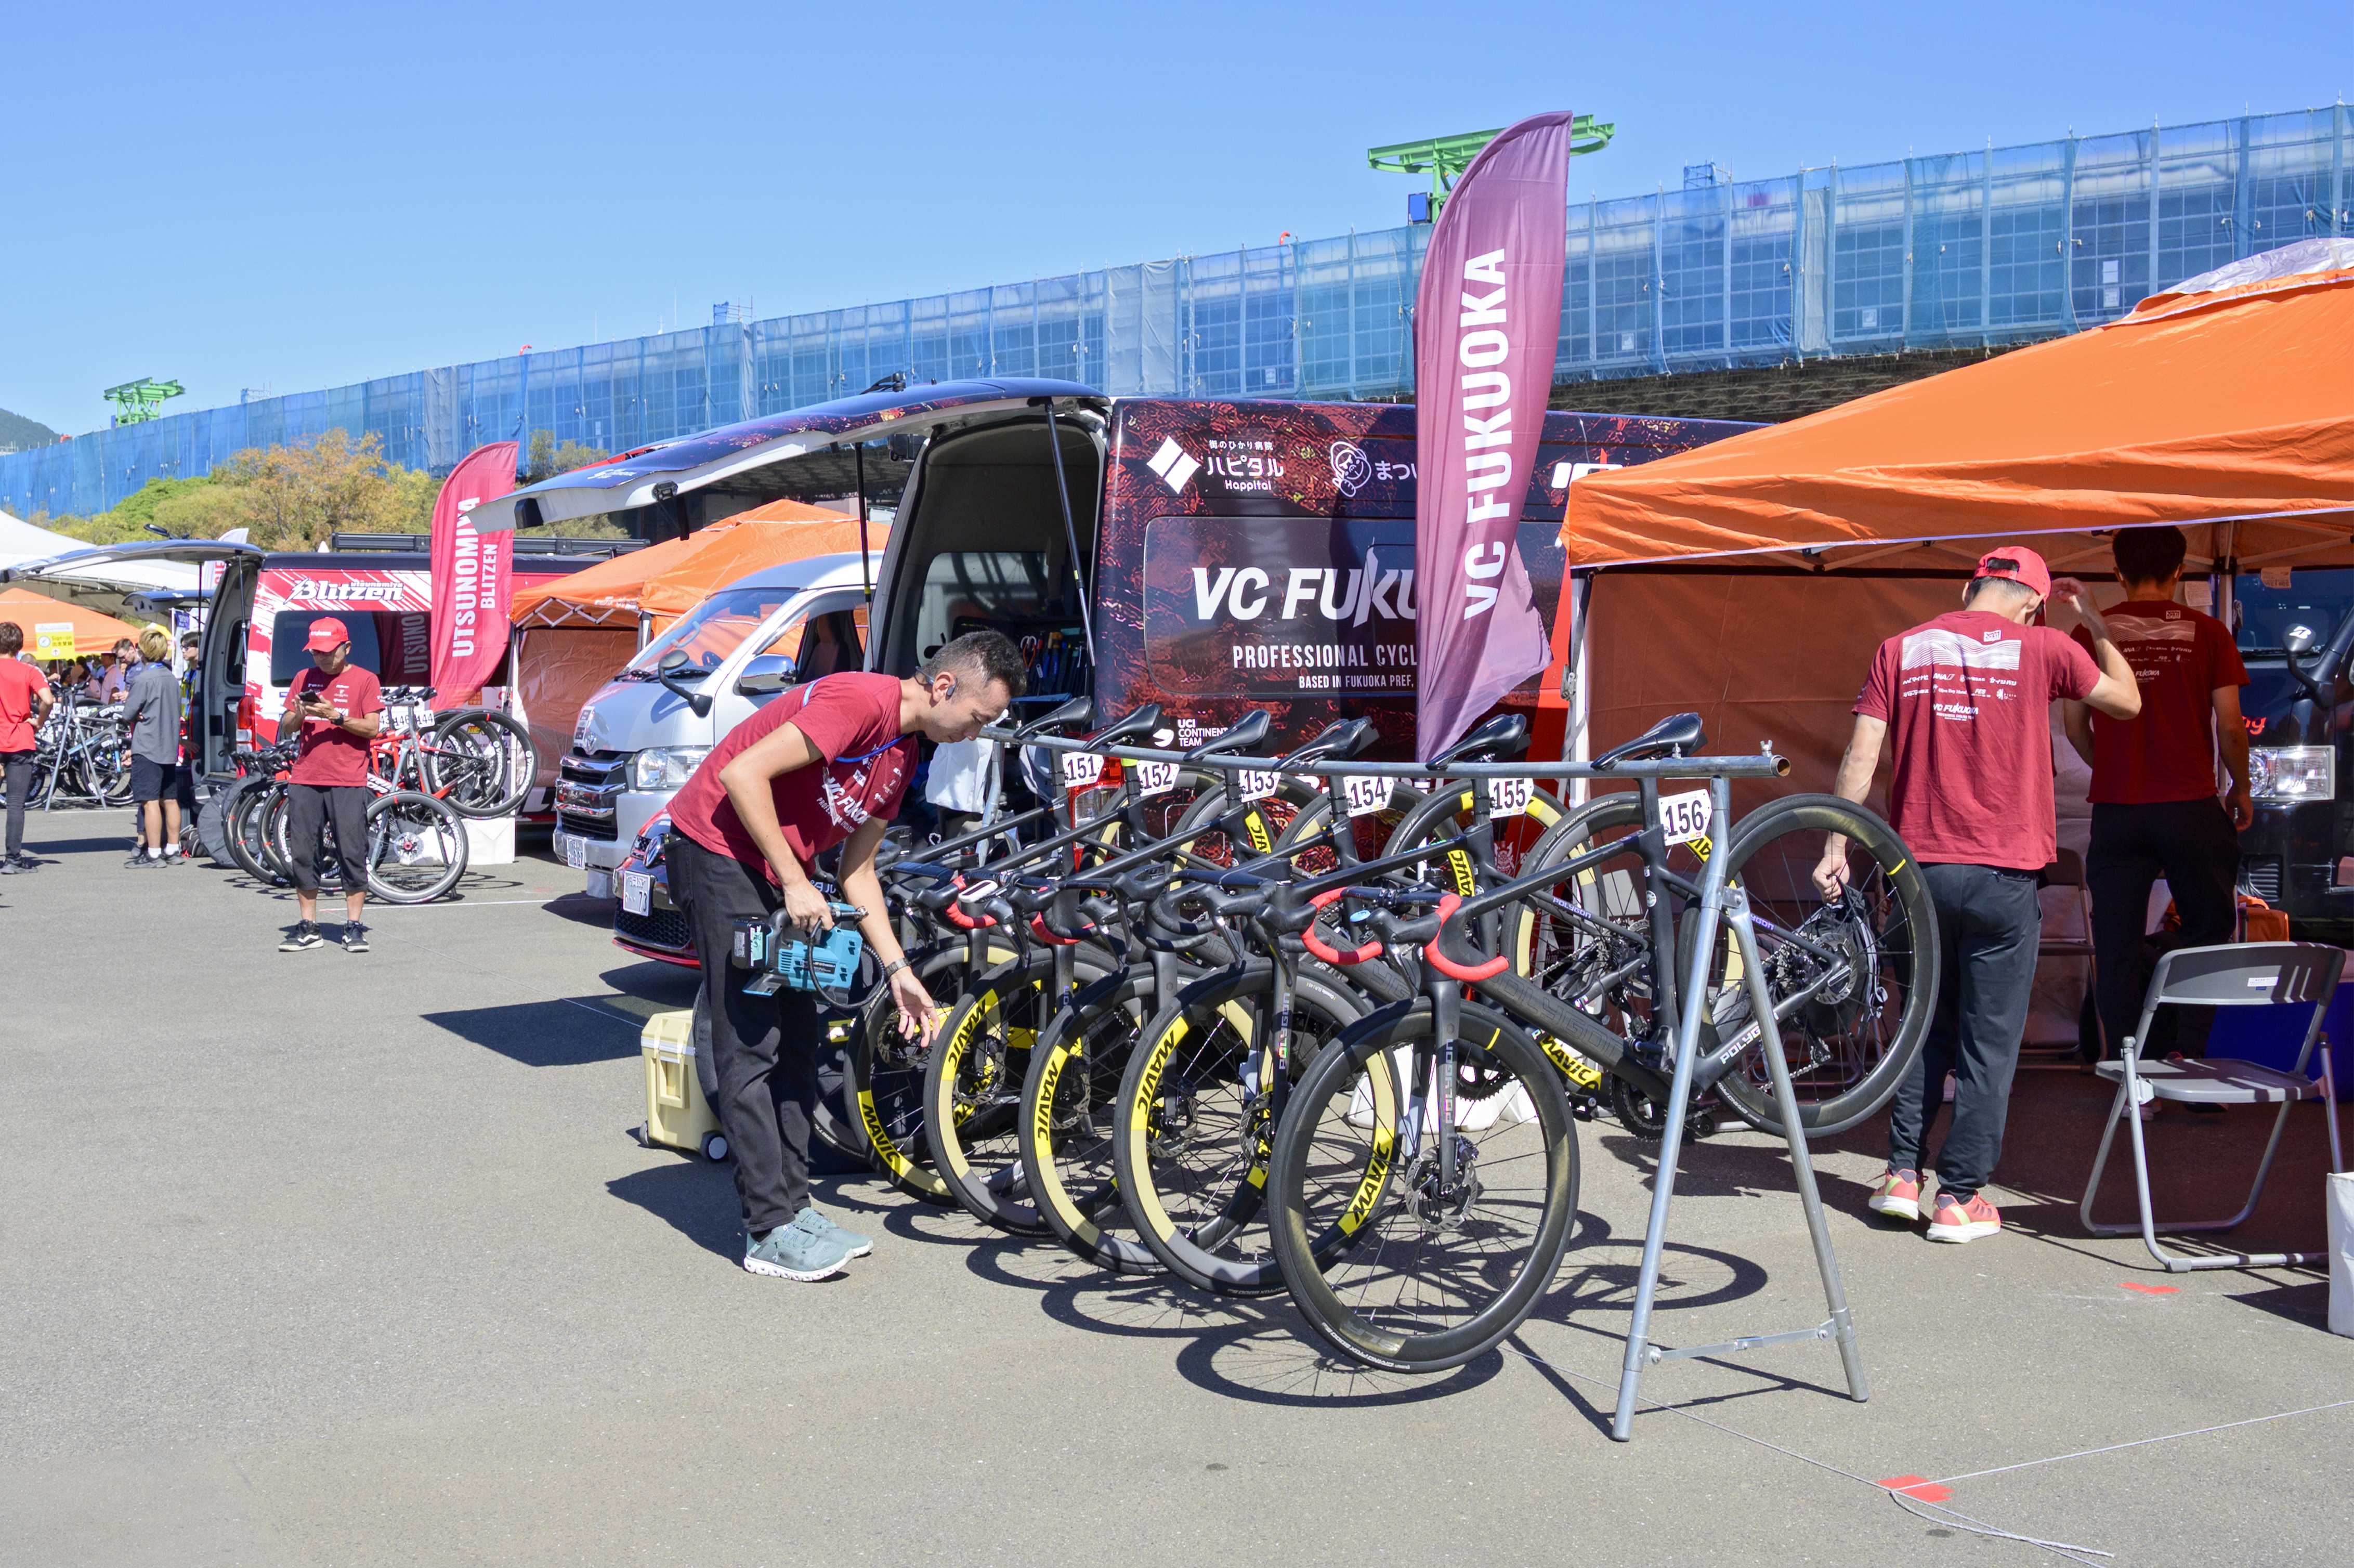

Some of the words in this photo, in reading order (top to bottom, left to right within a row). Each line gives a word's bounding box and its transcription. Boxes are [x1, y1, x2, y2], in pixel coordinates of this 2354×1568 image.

[1459, 247, 1513, 523] FUKUOKA
[1209, 439, 1274, 451] 街のひかり病院
[1207, 454, 1284, 478] ハピタル
[1224, 479, 1272, 492] Happital
[480, 543, 498, 609] BLITZEN
[283, 578, 404, 605] Blitzen
[1192, 567, 1271, 620] VC
[401, 611, 428, 674] UTSUNO
[1233, 644, 1368, 669] PROFESSIONAL
[1299, 675, 1330, 689] BASED
[1331, 675, 1342, 689] IN
[1344, 675, 1387, 689] FUKUOKA
[395, 714, 410, 726] 146
[417, 713, 433, 725] 144
[1177, 718, 1196, 728] UCI
[1179, 737, 1202, 747] TEAM
[1067, 755, 1097, 780] 151
[1143, 763, 1172, 789] 152
[1245, 770, 1274, 794] 153
[1351, 777, 1387, 809] 154
[1494, 779, 1526, 809] 155
[1556, 818, 1576, 837] GRAND
[1574, 810, 1591, 821] PRIX
[1590, 802, 1608, 813] 5000
[1666, 800, 1704, 837] 156
[1250, 825, 1268, 852] VIC
[810, 880, 836, 894] タル
[1552, 897, 1592, 919] POLYGON
[948, 998, 986, 1068] MAVIC
[1279, 992, 1290, 1070] POLYGON
[1720, 1012, 1779, 1065] POLYG
[1542, 1034, 1591, 1081] MAVIC
[1137, 1029, 1175, 1115] MAVIC
[1445, 1038, 1454, 1124] POLYGON
[1037, 1059, 1059, 1141] MAVIC
[1727, 1095, 1748, 1114] GRAND
[862, 1103, 900, 1163] MAVIC
[1353, 1141, 1390, 1225] MAVIC
[1330, 1331, 1352, 1349] 5000
[1349, 1346, 1369, 1358] PRIX
[1367, 1355, 1394, 1368] GRAND
